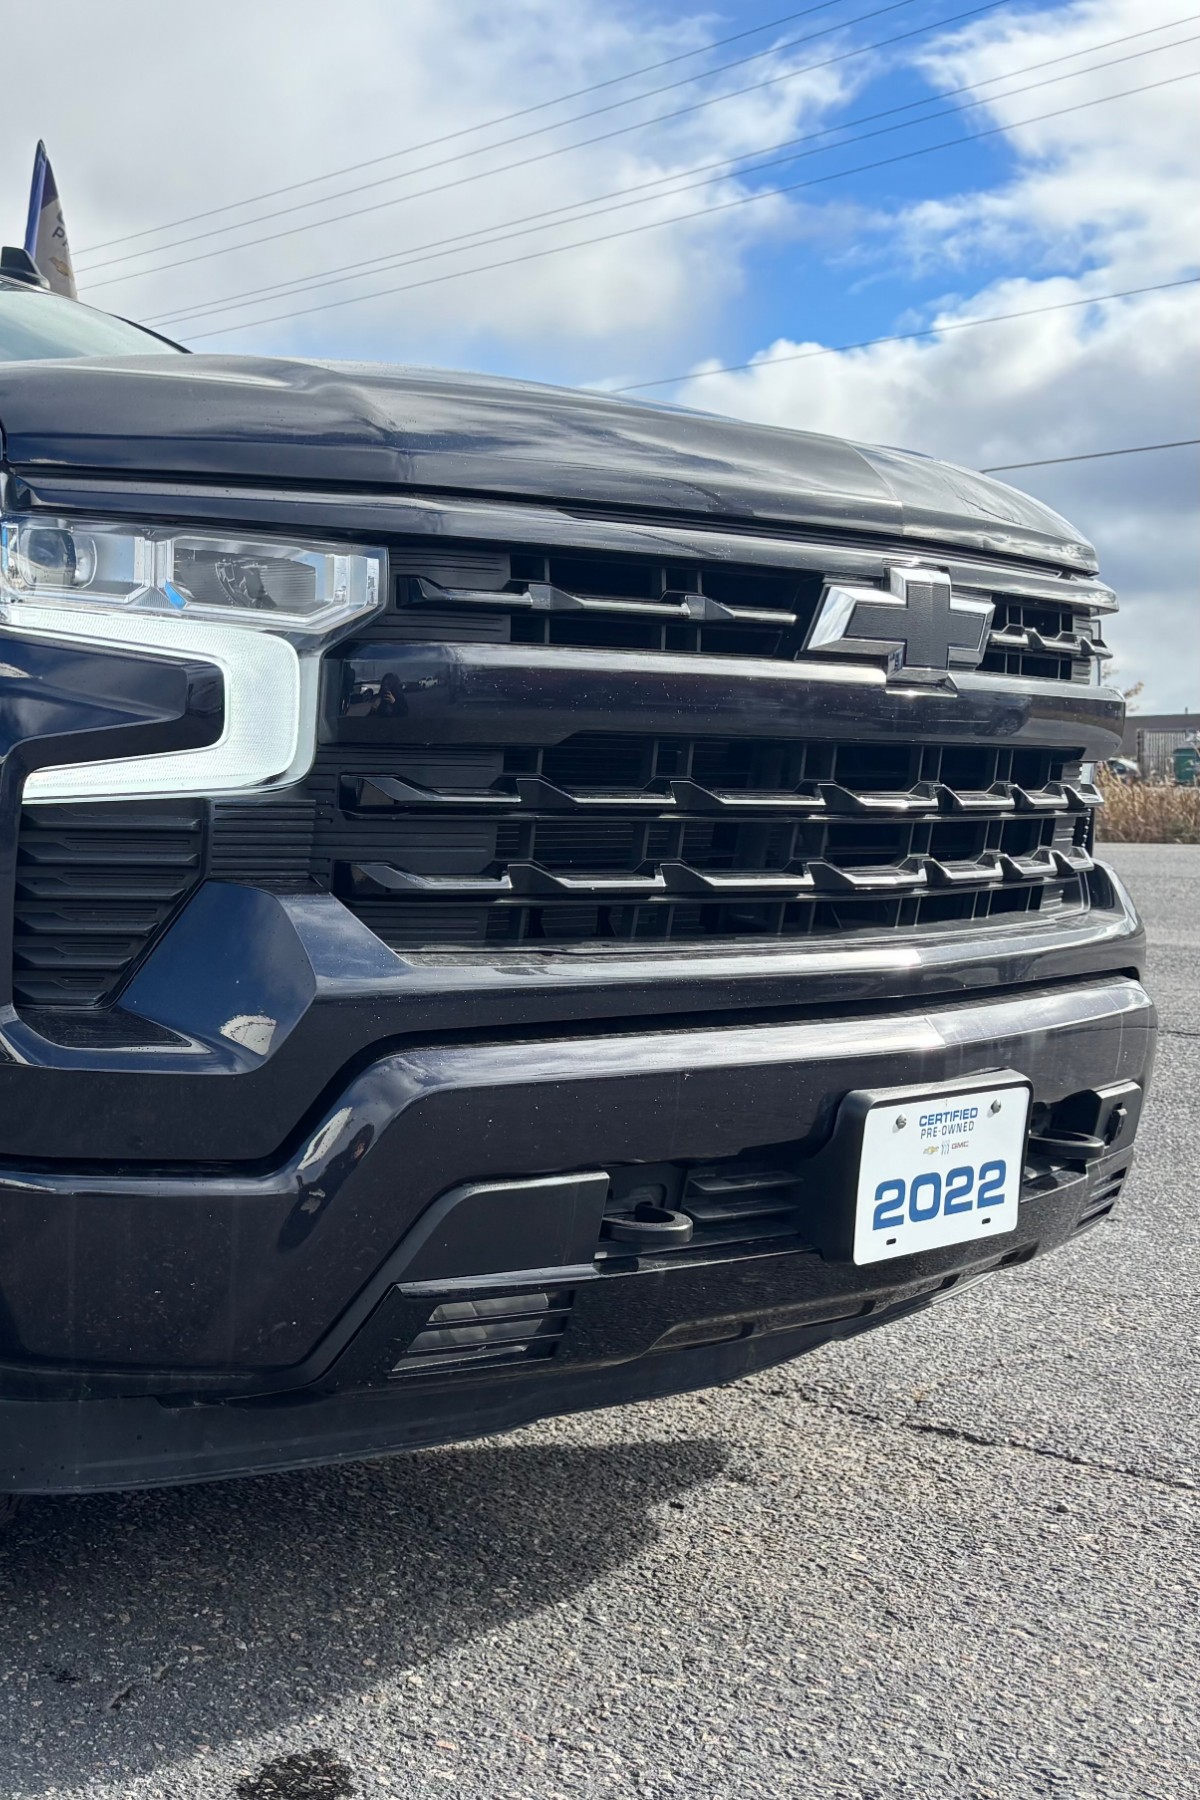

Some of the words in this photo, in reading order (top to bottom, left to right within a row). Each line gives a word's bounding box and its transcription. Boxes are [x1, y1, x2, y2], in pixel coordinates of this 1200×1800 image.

[919, 1107, 978, 1127] CERTIFIED
[920, 1120, 975, 1139] PRE-OWNED
[951, 1141, 969, 1150] GMC
[872, 1159, 1007, 1231] 2022
